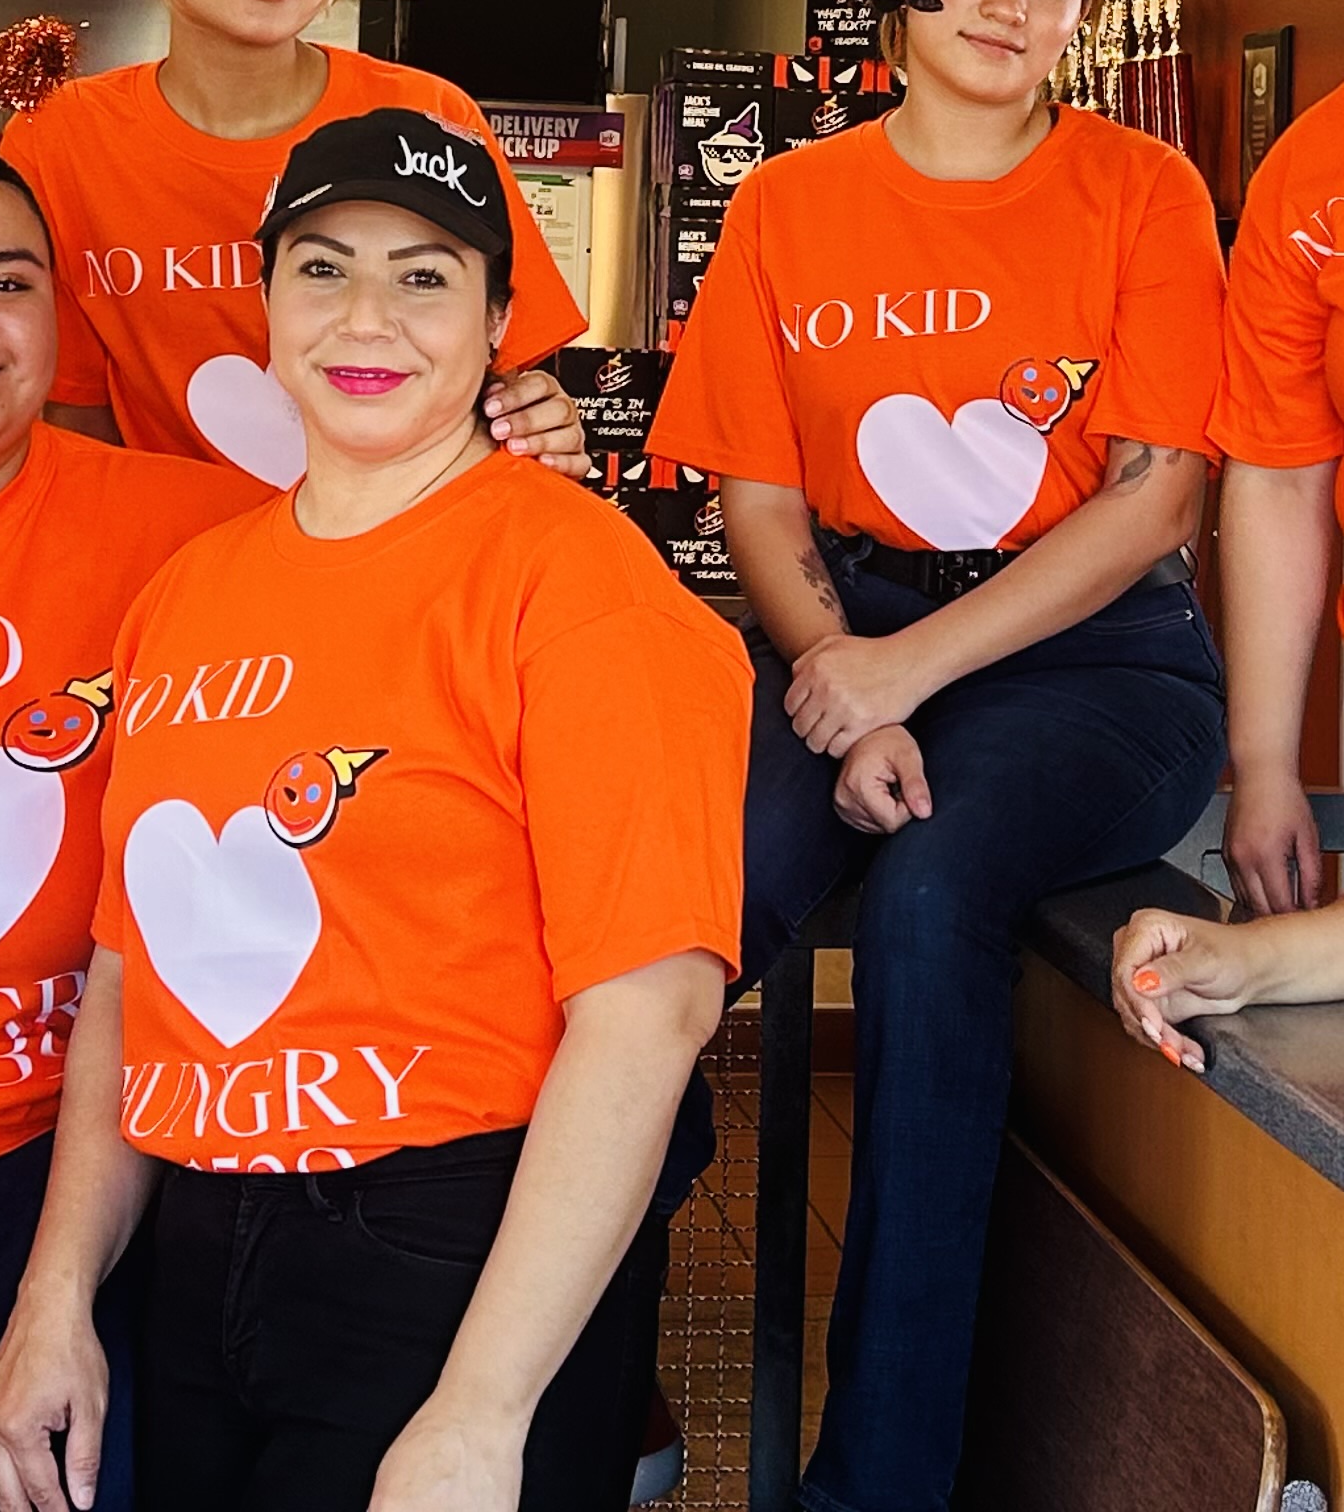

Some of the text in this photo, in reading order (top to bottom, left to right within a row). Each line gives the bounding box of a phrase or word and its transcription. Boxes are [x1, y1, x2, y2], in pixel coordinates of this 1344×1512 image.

[490, 114, 580, 139] DELIVERY
[393, 134, 487, 207] Jack
[81, 239, 265, 298] NO KID
[779, 288, 993, 354] NO KID
[626, 397, 645, 410] IN
[672, 551, 697, 566] THE
[167, 652, 295, 727] KID
